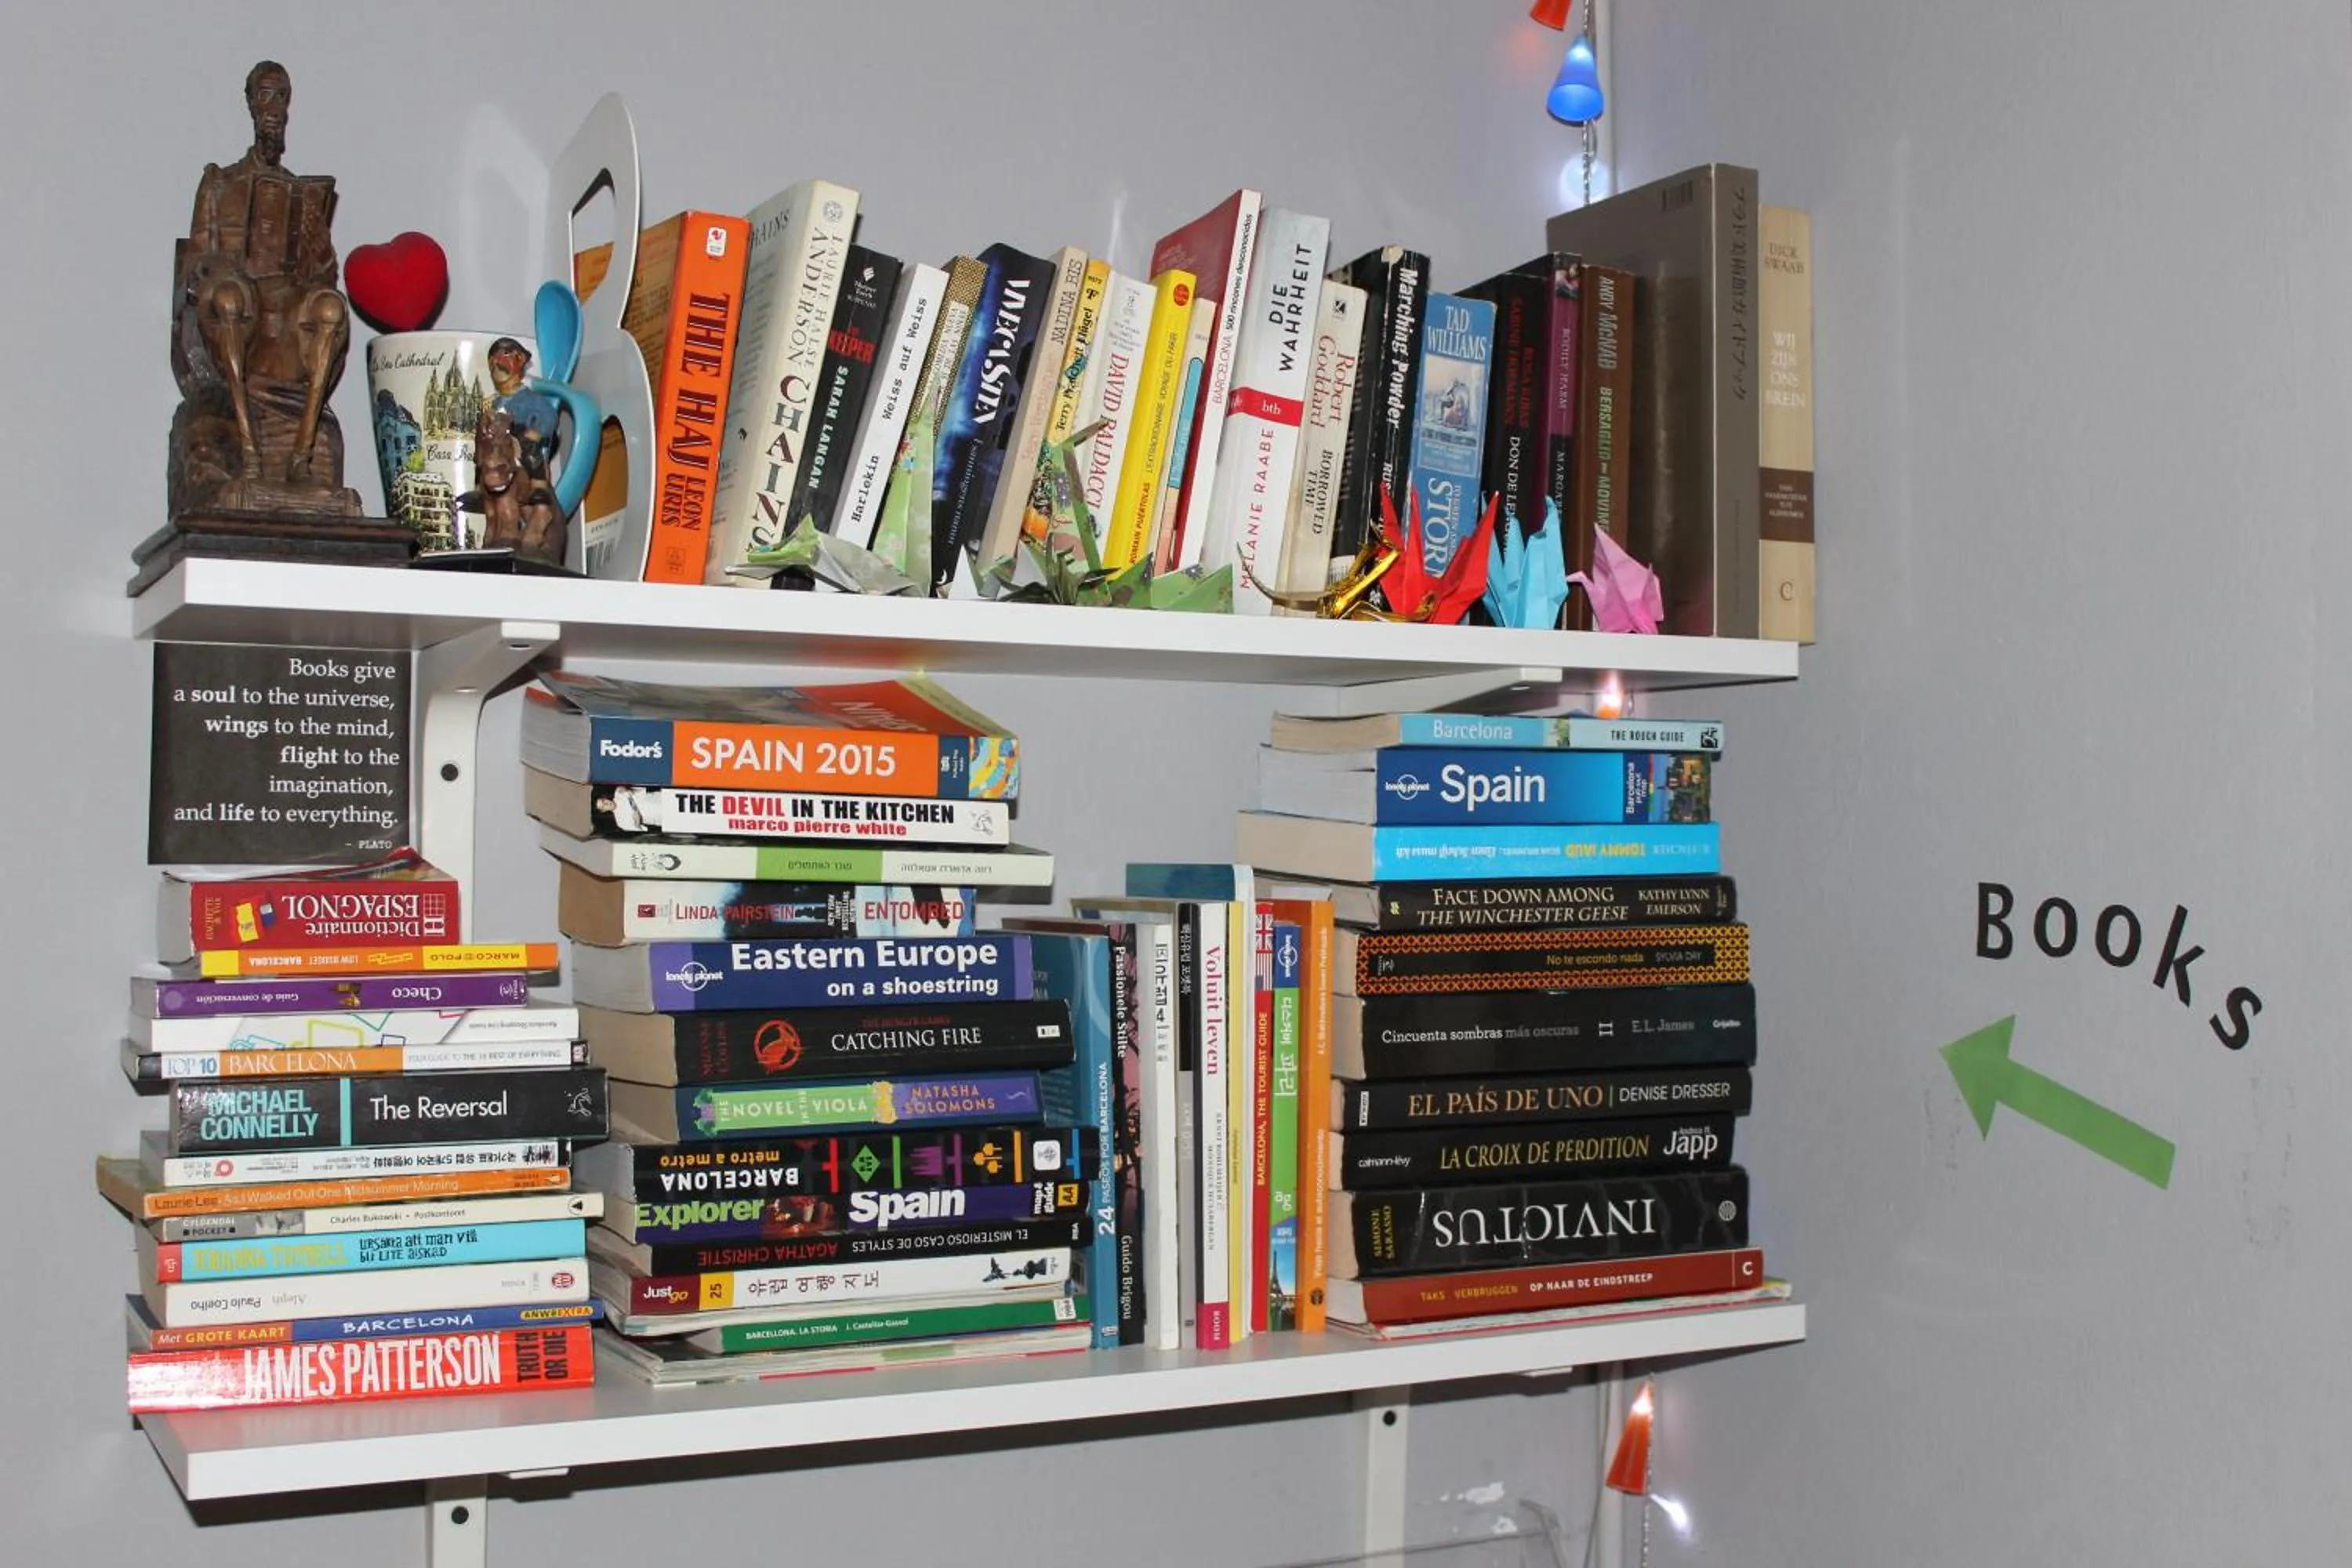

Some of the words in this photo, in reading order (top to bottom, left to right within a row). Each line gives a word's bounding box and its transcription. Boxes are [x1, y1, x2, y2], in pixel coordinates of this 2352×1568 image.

[1236, 213, 1252, 276] desconocidos
[786, 226, 829, 363] ANDERSON
[1229, 278, 1243, 311] rincones
[1269, 285, 1289, 325] DIE
[1599, 275, 1614, 309] ANDY
[1225, 312, 1237, 331] 500
[1279, 243, 1313, 373] WAHRHEIT
[1393, 267, 1418, 357] Marching
[1446, 305, 1469, 332] TAD
[680, 292, 730, 377] THE
[1427, 325, 1487, 362] WILLIAMS
[1597, 312, 1618, 370] McNAB
[883, 377, 902, 421] Weiss
[901, 347, 913, 371] auf
[909, 298, 927, 335] Weiss
[1212, 334, 1233, 405] BARCELONA
[826, 365, 849, 425] SARAH
[1105, 353, 1130, 411] DAVID
[1309, 334, 1336, 430] Goddard
[1332, 352, 1356, 422] Robert
[1387, 358, 1410, 430] Powder
[1261, 402, 1282, 416] btb
[670, 389, 718, 467] HAJ
[808, 427, 834, 489] LANGAN
[1508, 436, 1520, 470] DON
[851, 456, 880, 522] Harlekin
[1303, 470, 1318, 509] TIME
[1312, 449, 1333, 536] BORROWED
[1506, 473, 1518, 492] DE
[661, 474, 684, 526] URIS
[681, 476, 706, 530] LEON
[1240, 504, 1263, 589] MELANIE
[1255, 428, 1274, 495] RAABE
[289, 658, 349, 677] Books
[354, 662, 396, 684] give
[173, 688, 186, 702] a
[191, 685, 236, 702] soul
[243, 689, 263, 704] to
[269, 687, 299, 705] the
[305, 690, 395, 710] universe,
[205, 715, 268, 739] wings
[274, 718, 294, 734] to
[301, 717, 331, 735] the
[336, 718, 394, 739] mind,
[1433, 720, 1514, 740] Barcelona
[280, 746, 339, 769] flight
[344, 749, 364, 764] to
[369, 747, 400, 765] the
[600, 739, 663, 760] Fodor's
[690, 737, 805, 775] SPAIN
[815, 742, 897, 778] 2015
[270, 775, 394, 799] imagination,
[1440, 764, 1546, 811] Spain
[1625, 761, 1635, 815] Barcelona
[174, 803, 213, 821] and
[220, 803, 255, 822] life
[261, 806, 280, 822] to
[286, 804, 398, 829] everything.
[675, 793, 716, 815] THE
[721, 794, 786, 818] DEVIL
[790, 797, 815, 819] IN
[822, 799, 861, 820] THE
[865, 800, 955, 824] KITCHEN
[728, 818, 789, 833] marco
[794, 819, 851, 837] pierre
[855, 821, 908, 837] white
[358, 839, 392, 850] PLATO
[281, 893, 421, 920] ESPAGNOL
[1432, 887, 1478, 906] FACE
[1484, 887, 1542, 906] DOWN
[1547, 886, 1615, 904] AMONG
[1638, 888, 1677, 902] KATHY
[1679, 887, 1710, 900] LYNN
[1646, 902, 1702, 915] EMERSON
[305, 920, 421, 938] Dictionnaire
[865, 901, 964, 927] ENTOMBED
[1417, 908, 1459, 926] THE
[1461, 907, 1574, 925] WINCHESTER
[1577, 906, 1629, 922] GEESE
[249, 956, 303, 967] BARCELONA
[340, 955, 359, 966] LOW
[430, 953, 463, 964] POLO
[475, 952, 521, 962] MARCO
[731, 942, 864, 971] Eastern
[877, 940, 997, 971] Europe
[1976, 882, 2262, 1051] Books
[391, 985, 443, 1000] Checo
[827, 982, 853, 996] on
[862, 982, 875, 996] a
[881, 975, 999, 997] shoestring
[1114, 946, 1127, 1020] Passionele
[1206, 946, 1224, 1011] Voluit
[832, 1029, 935, 1052] CATCHING
[942, 1027, 982, 1046] FIRE
[1116, 1021, 1127, 1059] Stilte
[1258, 1011, 1268, 1047] GUIDE
[1381, 1029, 1447, 1044] Cincuenta
[1450, 1027, 1503, 1041] sombras
[1504, 1025, 1530, 1039] más
[1532, 1025, 1580, 1038] oscuras
[1206, 1018, 1223, 1076] leven
[165, 1054, 197, 1074] TOP
[199, 1053, 218, 1073] 10
[227, 1052, 358, 1073] BARCELONA
[1258, 1049, 1267, 1093] TOURIST
[1273, 1053, 1298, 1097] 파리
[209, 1089, 312, 1116] MICHAEL
[370, 1096, 410, 1120] The
[418, 1089, 508, 1117] Reversal
[904, 1098, 996, 1114] SOLOMONS
[911, 1085, 980, 1099] NATASHA
[1258, 1097, 1266, 1116] THE
[1407, 1095, 1440, 1116] EL
[1446, 1085, 1499, 1114] PAÍS
[1505, 1090, 1549, 1112] DE
[1555, 1087, 1604, 1109] UNO
[1618, 1085, 1668, 1102] DENISE
[1671, 1083, 1730, 1100] DRESSER
[200, 1113, 319, 1140] CONNELLY
[1256, 1120, 1267, 1186] BARCELONA,
[1439, 1148, 1461, 1169] LA
[1465, 1142, 1521, 1167] CROIX
[1528, 1140, 1551, 1163] DE
[1555, 1134, 1650, 1162] PERDITION
[1663, 1130, 1719, 1159] Japp
[661, 1167, 800, 1192] BARCELONA
[634, 1199, 765, 1228] Explorer
[848, 1189, 965, 1227] Spain
[1432, 1198, 1657, 1247] INVICTUS
[192, 1226, 227, 1236] POCKET
[699, 1247, 770, 1267] CHRISTIE
[777, 1241, 838, 1259] AGATHA
[1120, 1235, 1132, 1274] Guido
[191, 1299, 228, 1312] Coelho
[230, 1297, 261, 1309] Paulo
[185, 1330, 233, 1344] GROTE
[238, 1327, 285, 1341] KAART
[343, 1313, 475, 1334] BARCELONA
[515, 1331, 541, 1383] TRUTH
[542, 1330, 568, 1356] DIE
[241, 1341, 338, 1402] JAMES
[343, 1331, 502, 1396] PATTERSON
[543, 1357, 568, 1380] OR
